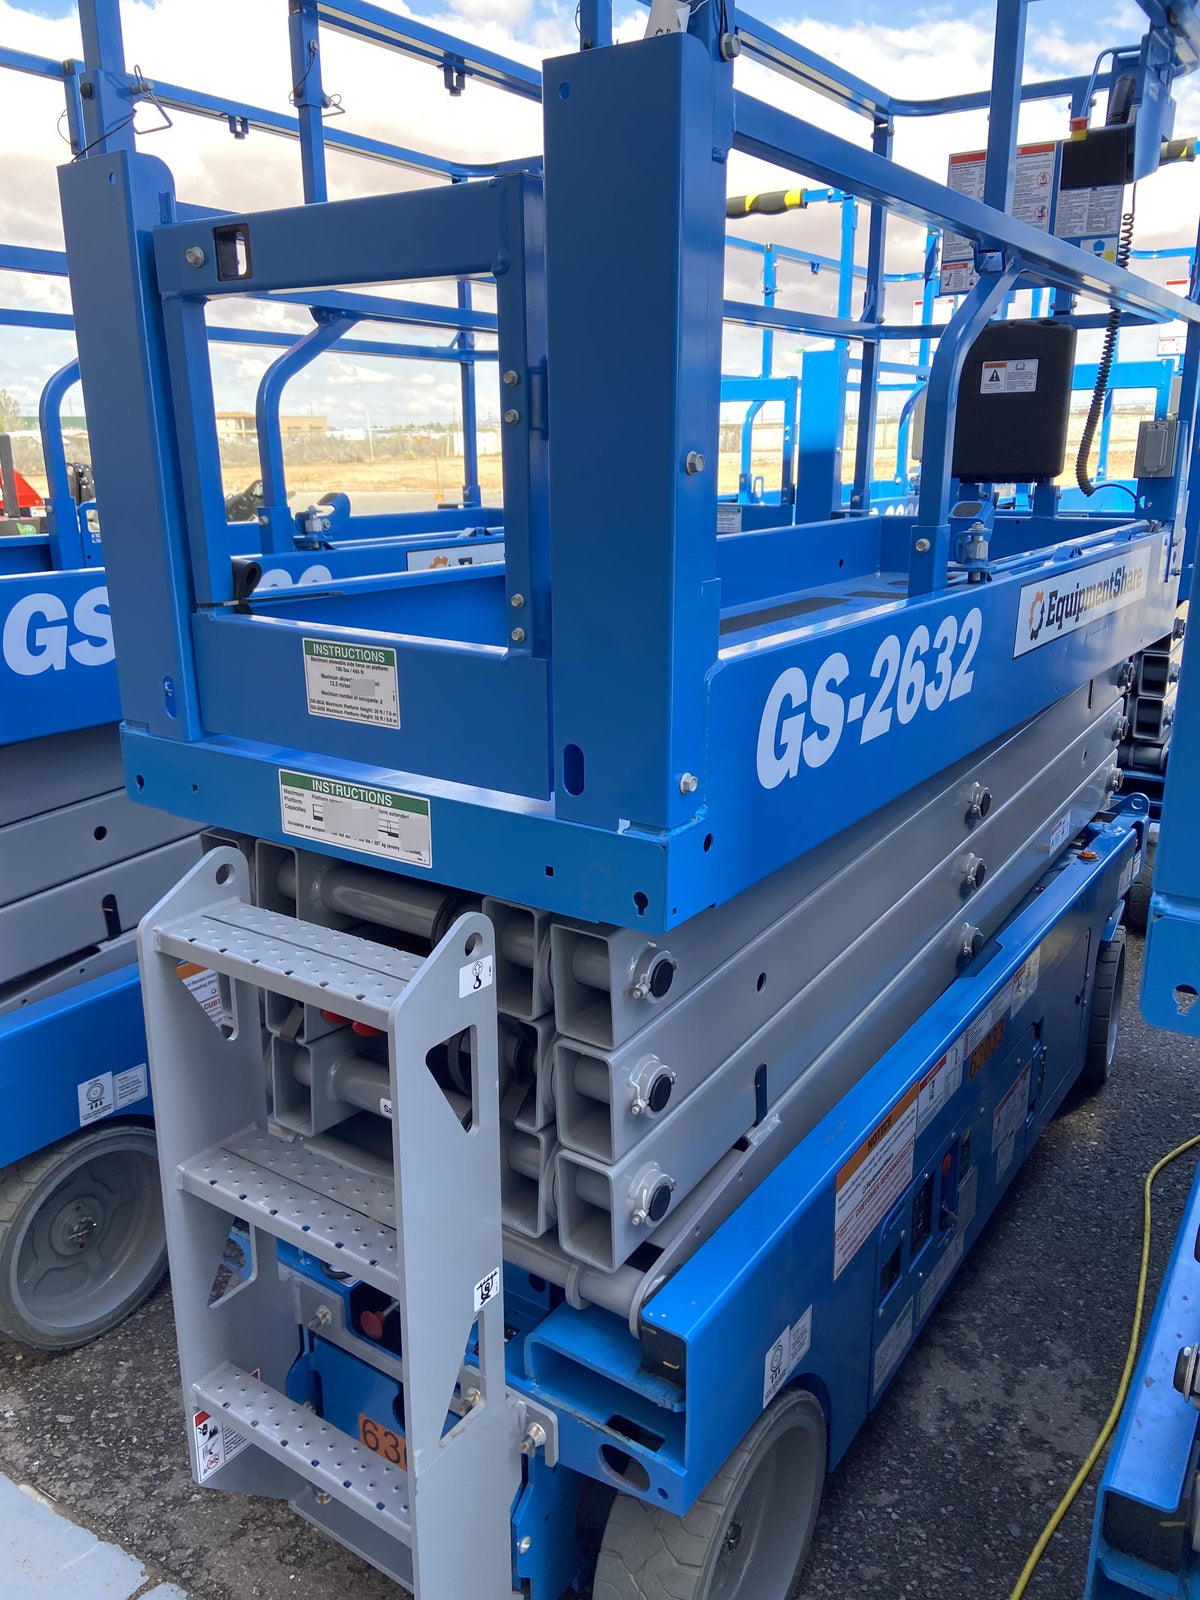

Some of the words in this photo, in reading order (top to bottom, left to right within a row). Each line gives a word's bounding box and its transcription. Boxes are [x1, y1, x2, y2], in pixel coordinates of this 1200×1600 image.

[1046, 566, 1143, 630] EquipmentShare
[313, 643, 385, 663] INSTRUCTIONS
[756, 607, 983, 789] GS-2632
[284, 788, 304, 797] Maximum
[284, 796, 303, 804] Platform
[312, 779, 393, 807] INSTRUCTIONS
[867, 1115, 892, 1151] NOTICE
[362, 1419, 407, 1468] 63
